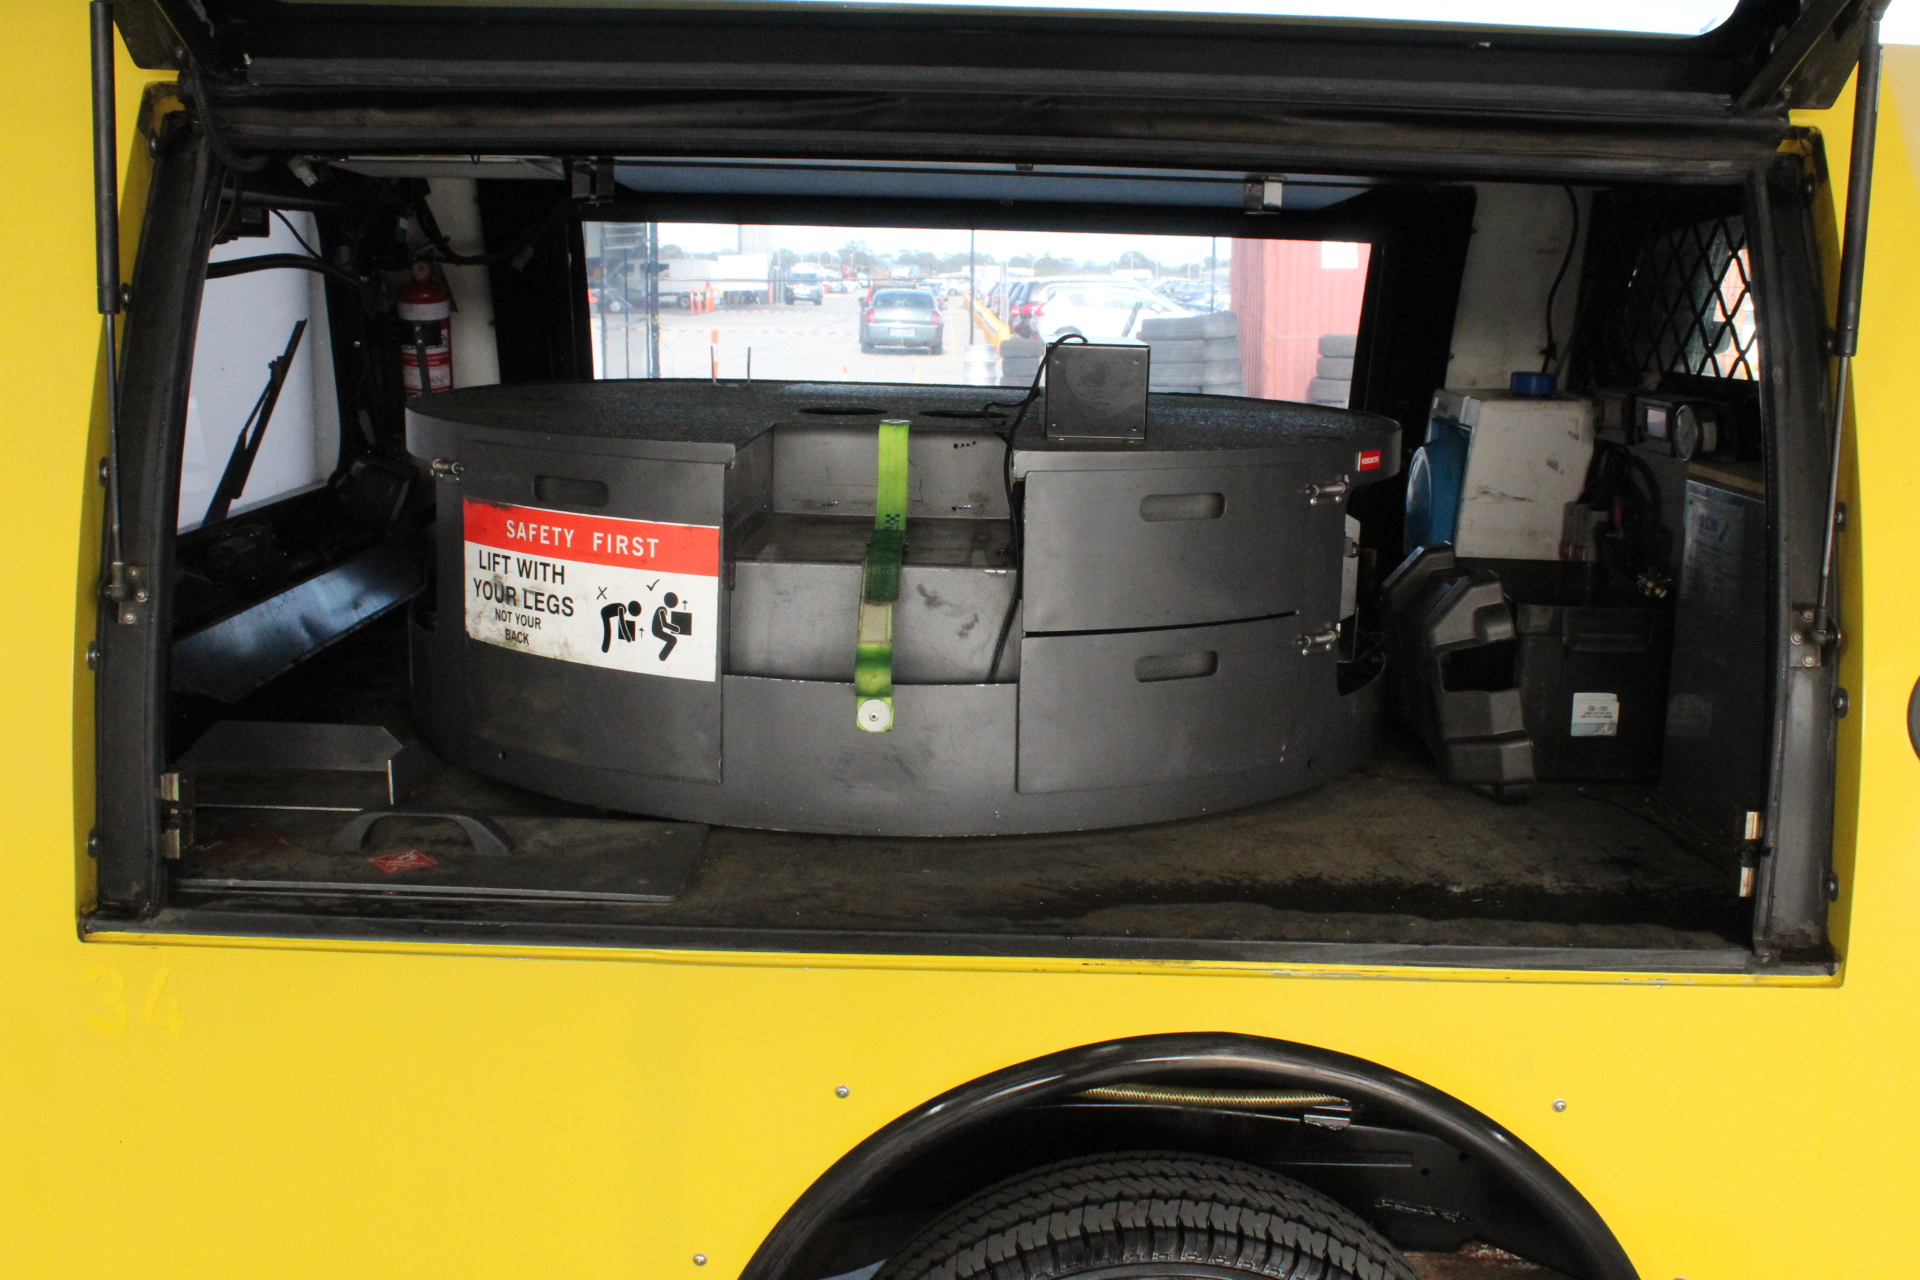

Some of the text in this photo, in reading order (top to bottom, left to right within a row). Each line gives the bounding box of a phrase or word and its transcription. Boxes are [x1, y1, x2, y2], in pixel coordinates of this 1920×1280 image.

[506, 519, 660, 558] SAFETY FIRST
[479, 549, 565, 586] LIFT WITH
[473, 577, 574, 617] YOUR LEGS
[495, 608, 542, 630] NOT YOUR
[505, 627, 530, 646] BACK
[84, 965, 186, 1036] 34
